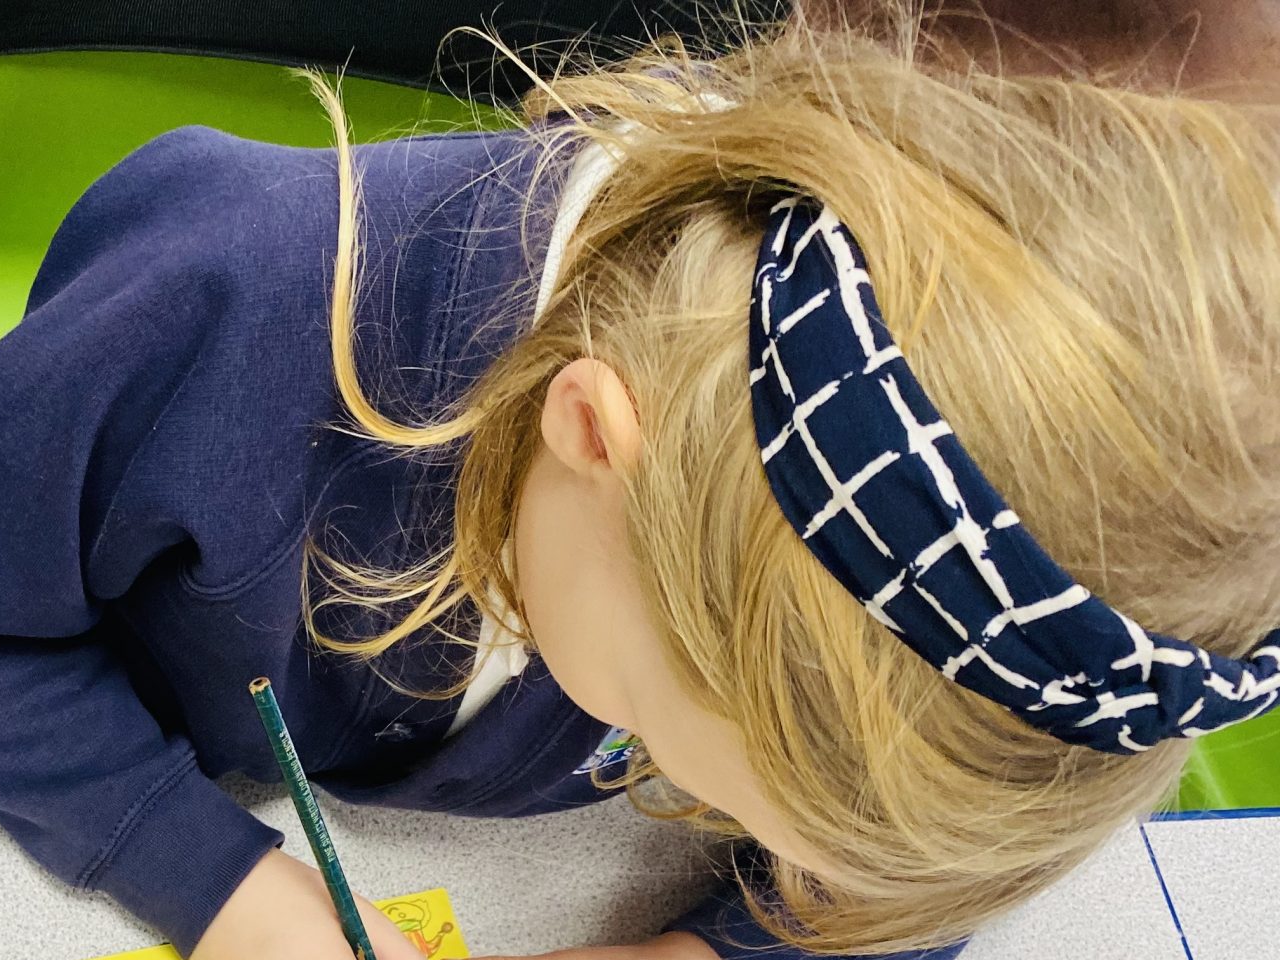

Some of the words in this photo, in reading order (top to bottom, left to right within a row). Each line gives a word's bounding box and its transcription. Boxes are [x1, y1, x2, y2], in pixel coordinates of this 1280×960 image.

[290, 760, 309, 790] DRAWING
[304, 795, 321, 823] WRITING
[315, 821, 331, 848] QUALITY
[324, 847, 336, 863] FINE
